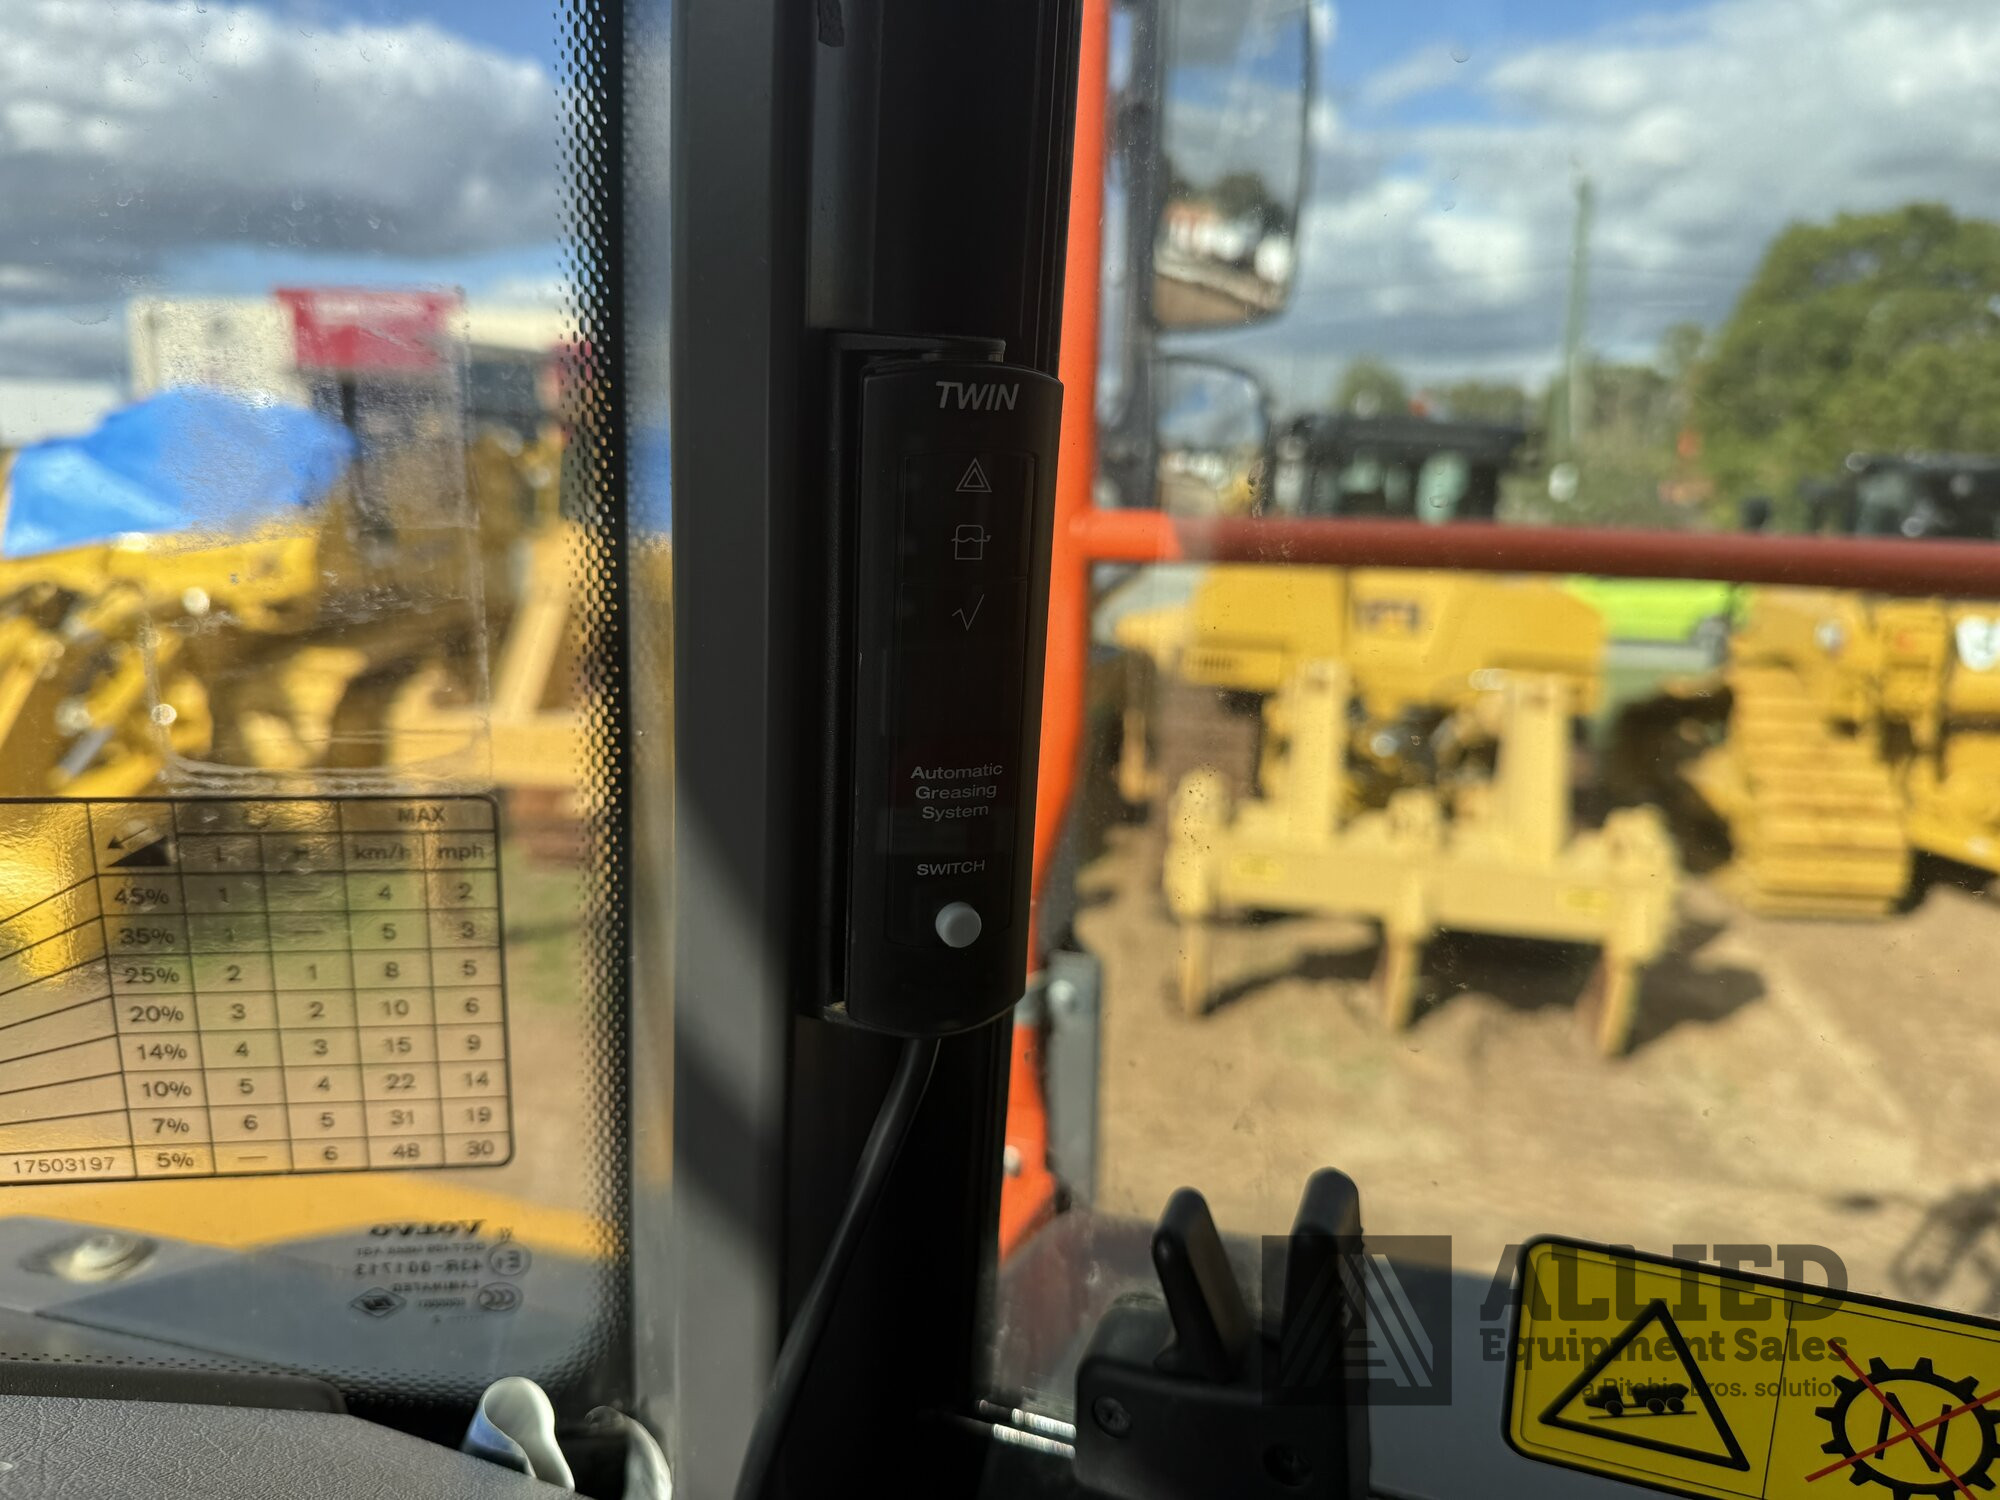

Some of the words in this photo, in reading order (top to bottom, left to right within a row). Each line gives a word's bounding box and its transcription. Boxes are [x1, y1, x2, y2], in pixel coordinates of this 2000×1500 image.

[935, 381, 1020, 411] TWIN
[911, 763, 1003, 780] Automatic
[915, 784, 997, 800] Greasing
[397, 806, 446, 822] MAX
[922, 805, 989, 822] System
[354, 843, 411, 861] km/h
[438, 845, 485, 862] mph
[916, 860, 986, 876] SWITCH
[114, 886, 170, 906] 45%
[377, 884, 393, 901] 4
[457, 882, 473, 900] 2
[119, 927, 175, 946] 35%
[381, 922, 397, 941] 5
[461, 920, 476, 939] 3
[124, 966, 181, 985] 25%
[226, 964, 242, 982] 2
[306, 963, 318, 980] 1
[384, 961, 400, 979] 8
[462, 958, 478, 977] 5
[129, 1005, 185, 1023] 20%
[231, 1002, 246, 1020] 3
[309, 1000, 326, 1019] 2
[380, 998, 410, 1016] 10
[464, 997, 480, 1015] 6
[136, 1043, 188, 1061] 14%
[235, 1040, 250, 1058] 4
[312, 1038, 329, 1056] 3
[383, 1036, 413, 1054] 15
[466, 1033, 482, 1051] 9
[142, 1080, 193, 1098] 10%
[239, 1077, 255, 1095] 5
[316, 1075, 332, 1092] 4
[385, 1072, 417, 1091] 22
[464, 1071, 490, 1088] 14
[152, 1117, 190, 1134] 7%
[243, 1114, 259, 1131] 6
[320, 1111, 336, 1128] 5
[389, 1108, 415, 1126] 31
[465, 1106, 493, 1123] 19
[13, 1156, 116, 1174] 17503197
[157, 1152, 195, 1168] 5%
[323, 1145, 339, 1162] 6
[392, 1142, 421, 1159] 48
[466, 1139, 496, 1157] 30
